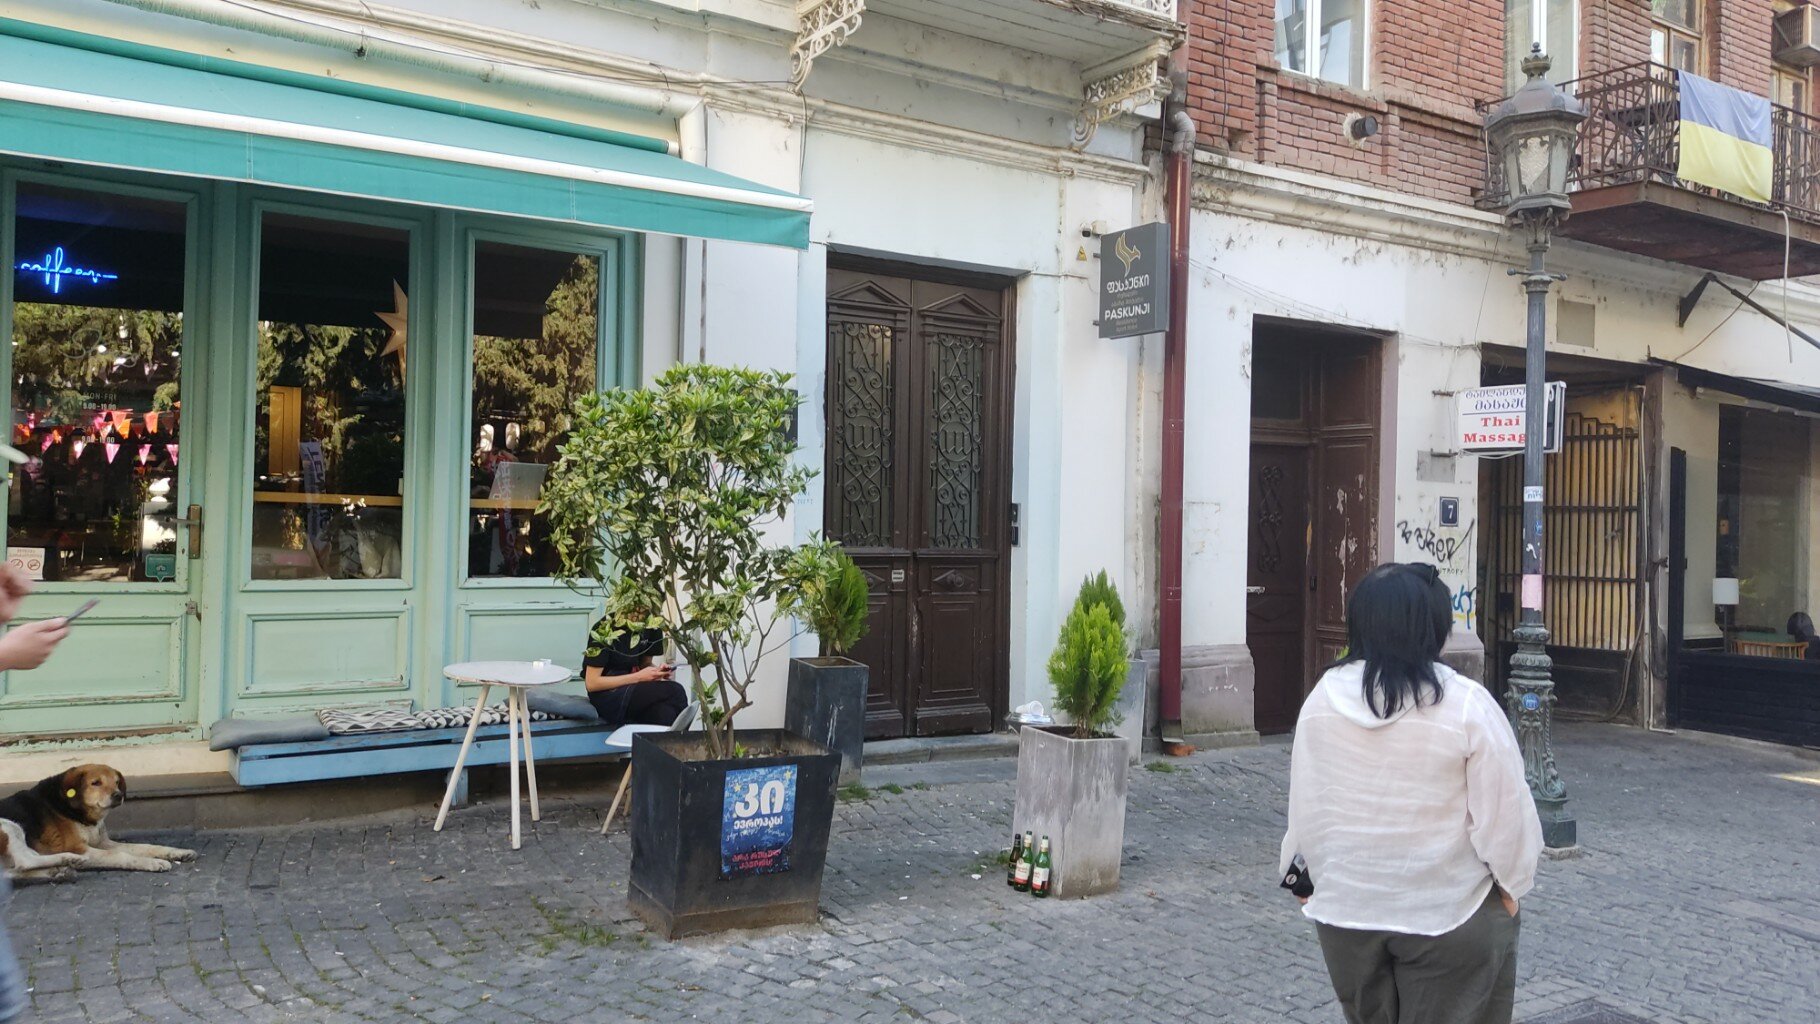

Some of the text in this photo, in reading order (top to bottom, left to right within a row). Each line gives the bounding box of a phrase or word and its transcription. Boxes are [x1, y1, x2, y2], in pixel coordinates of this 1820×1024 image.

[1104, 302, 1149, 320] PASKUNJI
[1480, 415, 1520, 427] Thai
[1463, 432, 1527, 444] Massag
[1447, 504, 1455, 520] 7
[735, 781, 784, 817] კი
